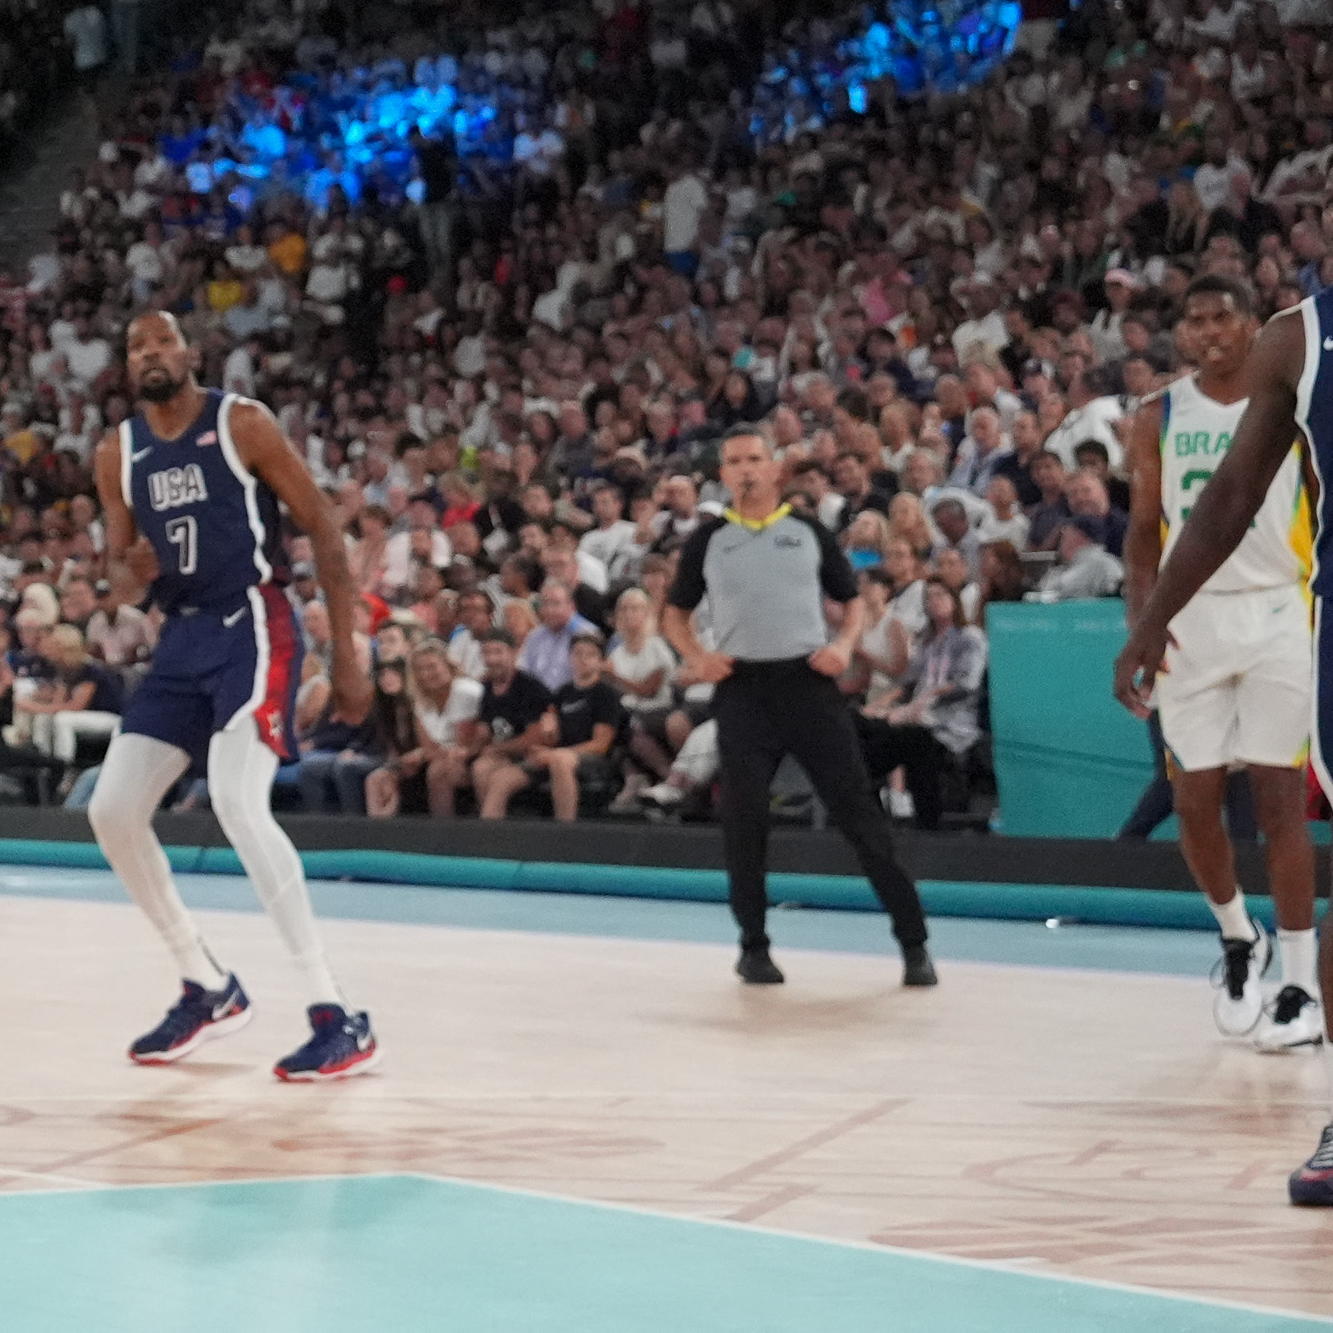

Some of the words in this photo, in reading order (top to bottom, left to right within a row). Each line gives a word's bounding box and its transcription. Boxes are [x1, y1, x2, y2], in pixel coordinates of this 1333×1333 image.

[1174, 429, 1233, 457] BRA
[147, 463, 208, 512] USA
[165, 515, 198, 576] 7
